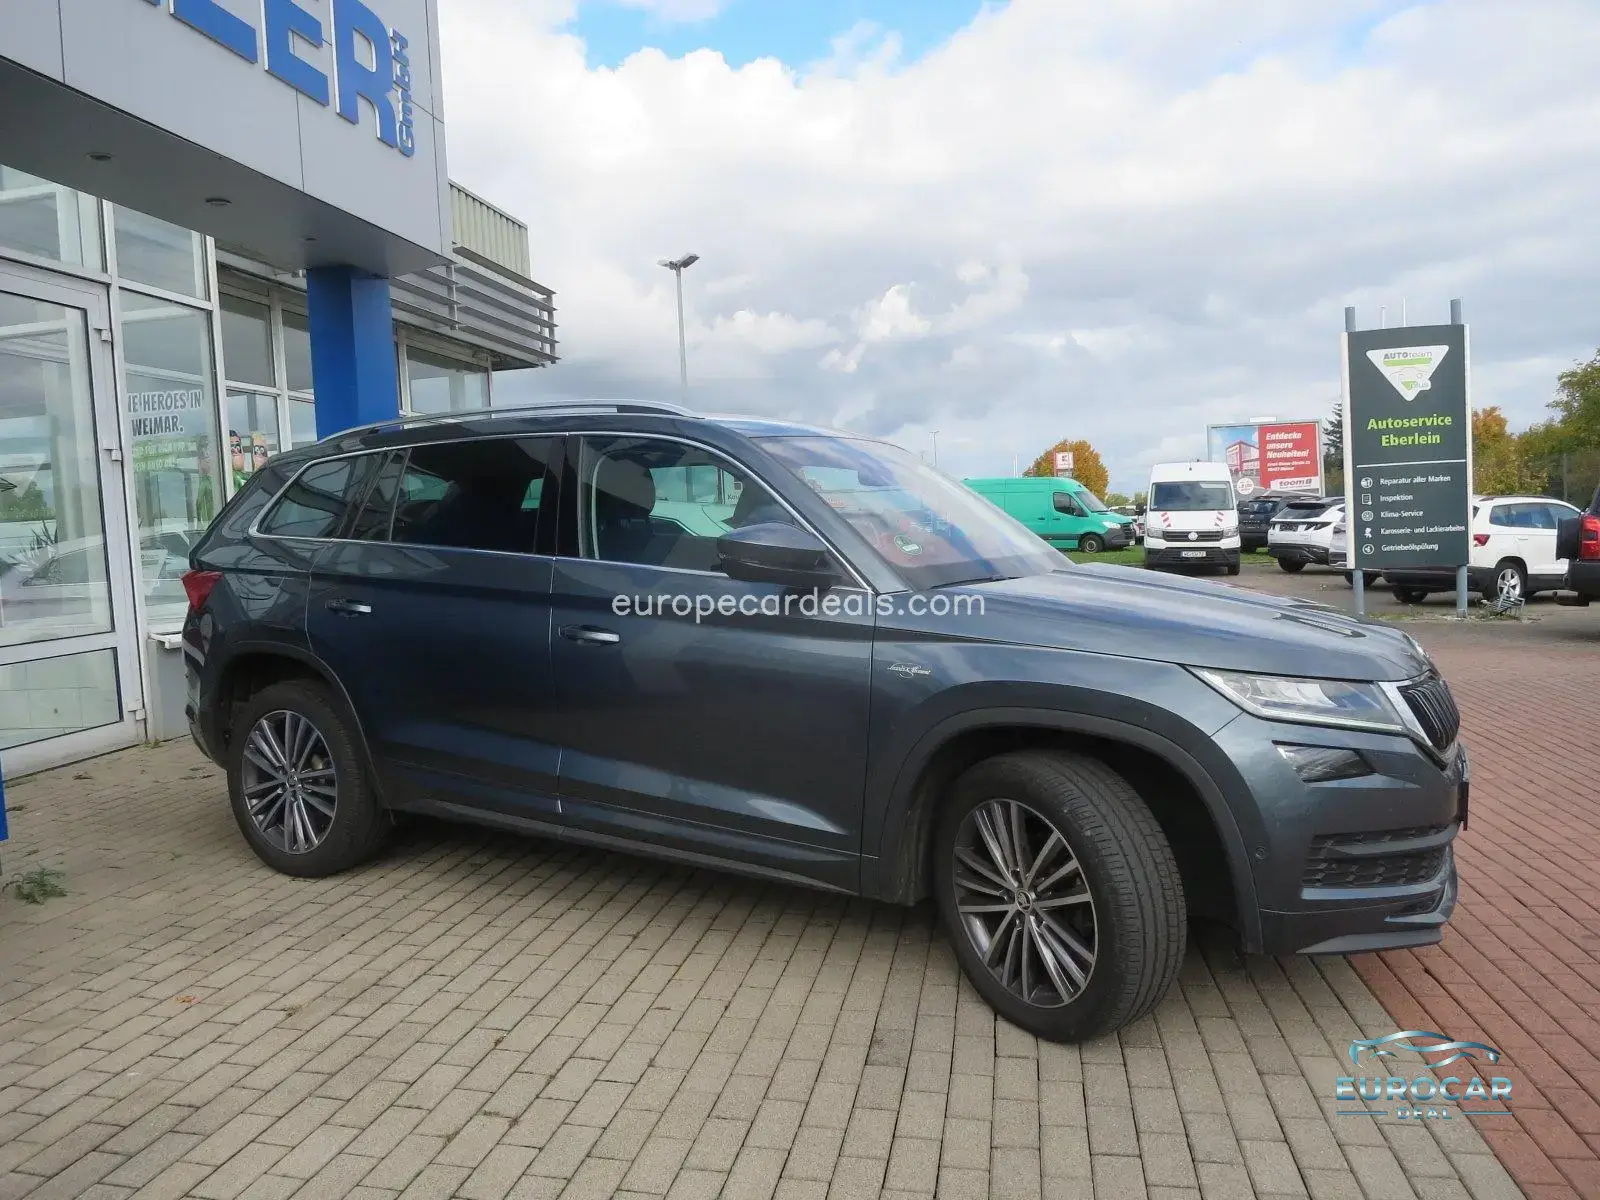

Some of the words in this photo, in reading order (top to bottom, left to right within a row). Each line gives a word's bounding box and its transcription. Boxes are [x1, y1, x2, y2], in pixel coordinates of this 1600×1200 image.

[143, 391, 187, 412] HEROES
[190, 391, 201, 409] IN
[131, 415, 184, 437] WEIMAR.
[1367, 413, 1453, 430] Autoservice
[1266, 432, 1302, 440] Entdecke
[1381, 432, 1441, 447] Eberlein
[1266, 442, 1293, 450] unsere
[1267, 450, 1309, 458] Neuheiten!
[1380, 478, 1411, 486] Reparatur
[1380, 494, 1413, 503] Inspektion
[1380, 510, 1424, 518] Klima-Service
[1380, 527, 1413, 535] Karosserie-
[1426, 524, 1466, 533] Lackierarbeiten
[1382, 543, 1439, 552] Getriebeölspülung
